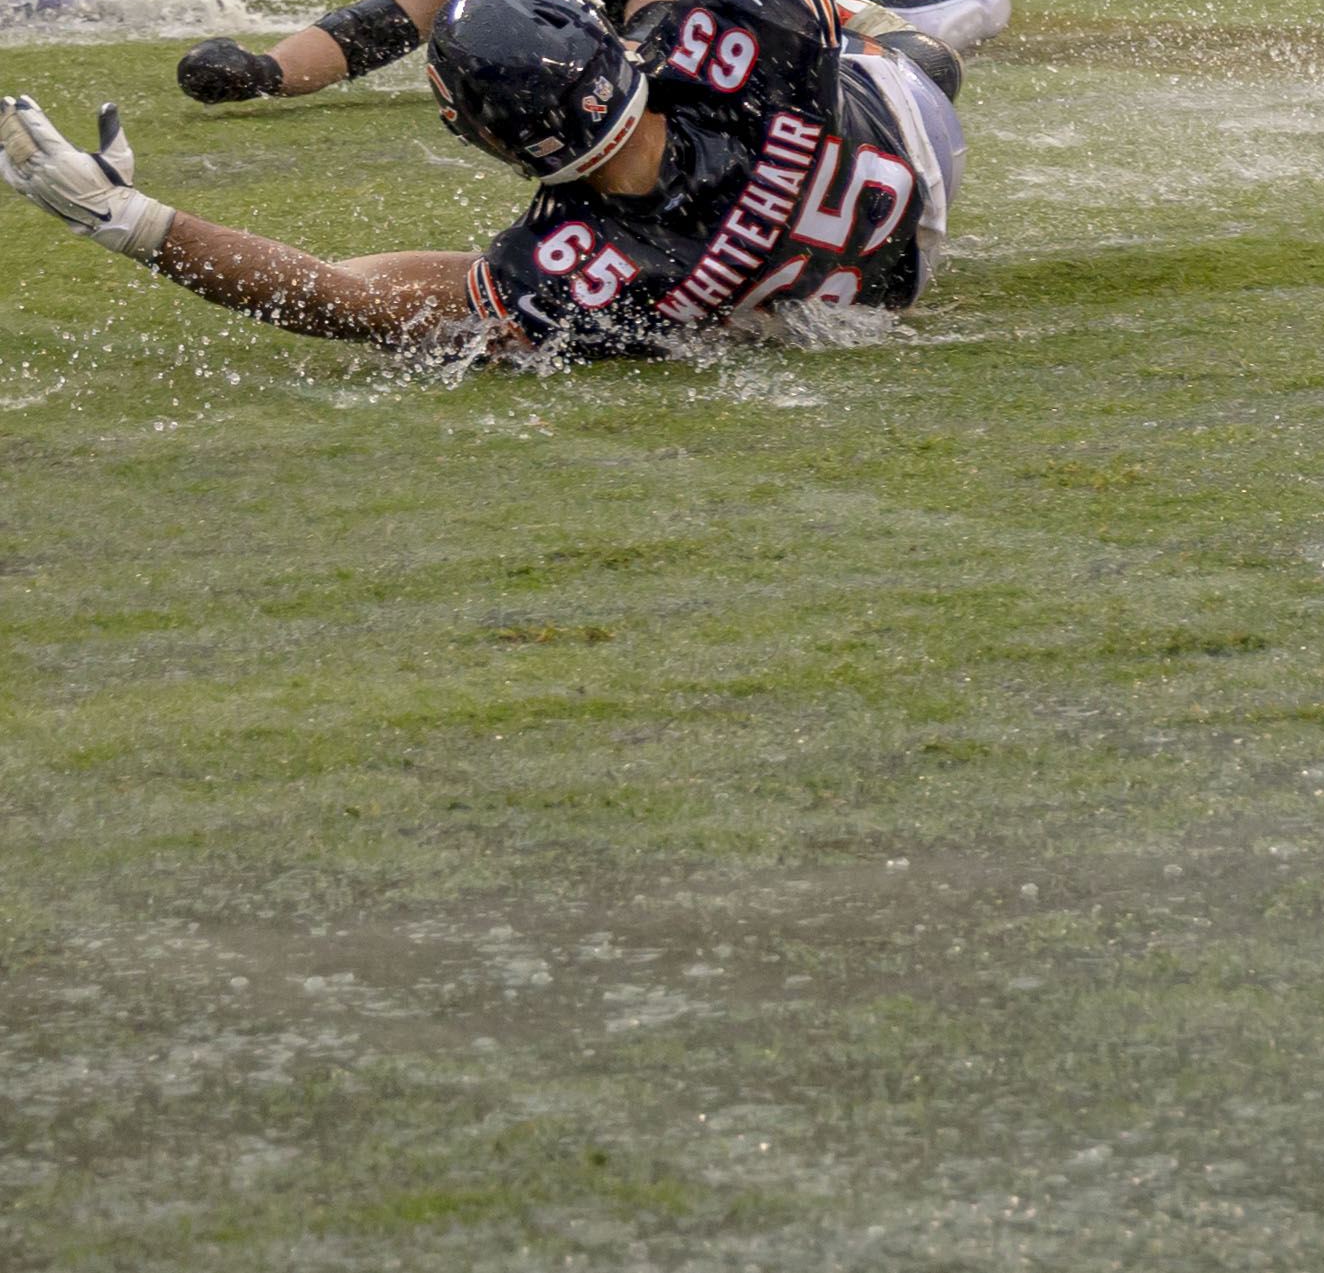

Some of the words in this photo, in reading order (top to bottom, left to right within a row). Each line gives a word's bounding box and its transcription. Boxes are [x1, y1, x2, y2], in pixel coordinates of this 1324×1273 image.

[667, 7, 760, 94] 65
[654, 111, 824, 326] WHITEHAIR
[534, 221, 642, 310] 65
